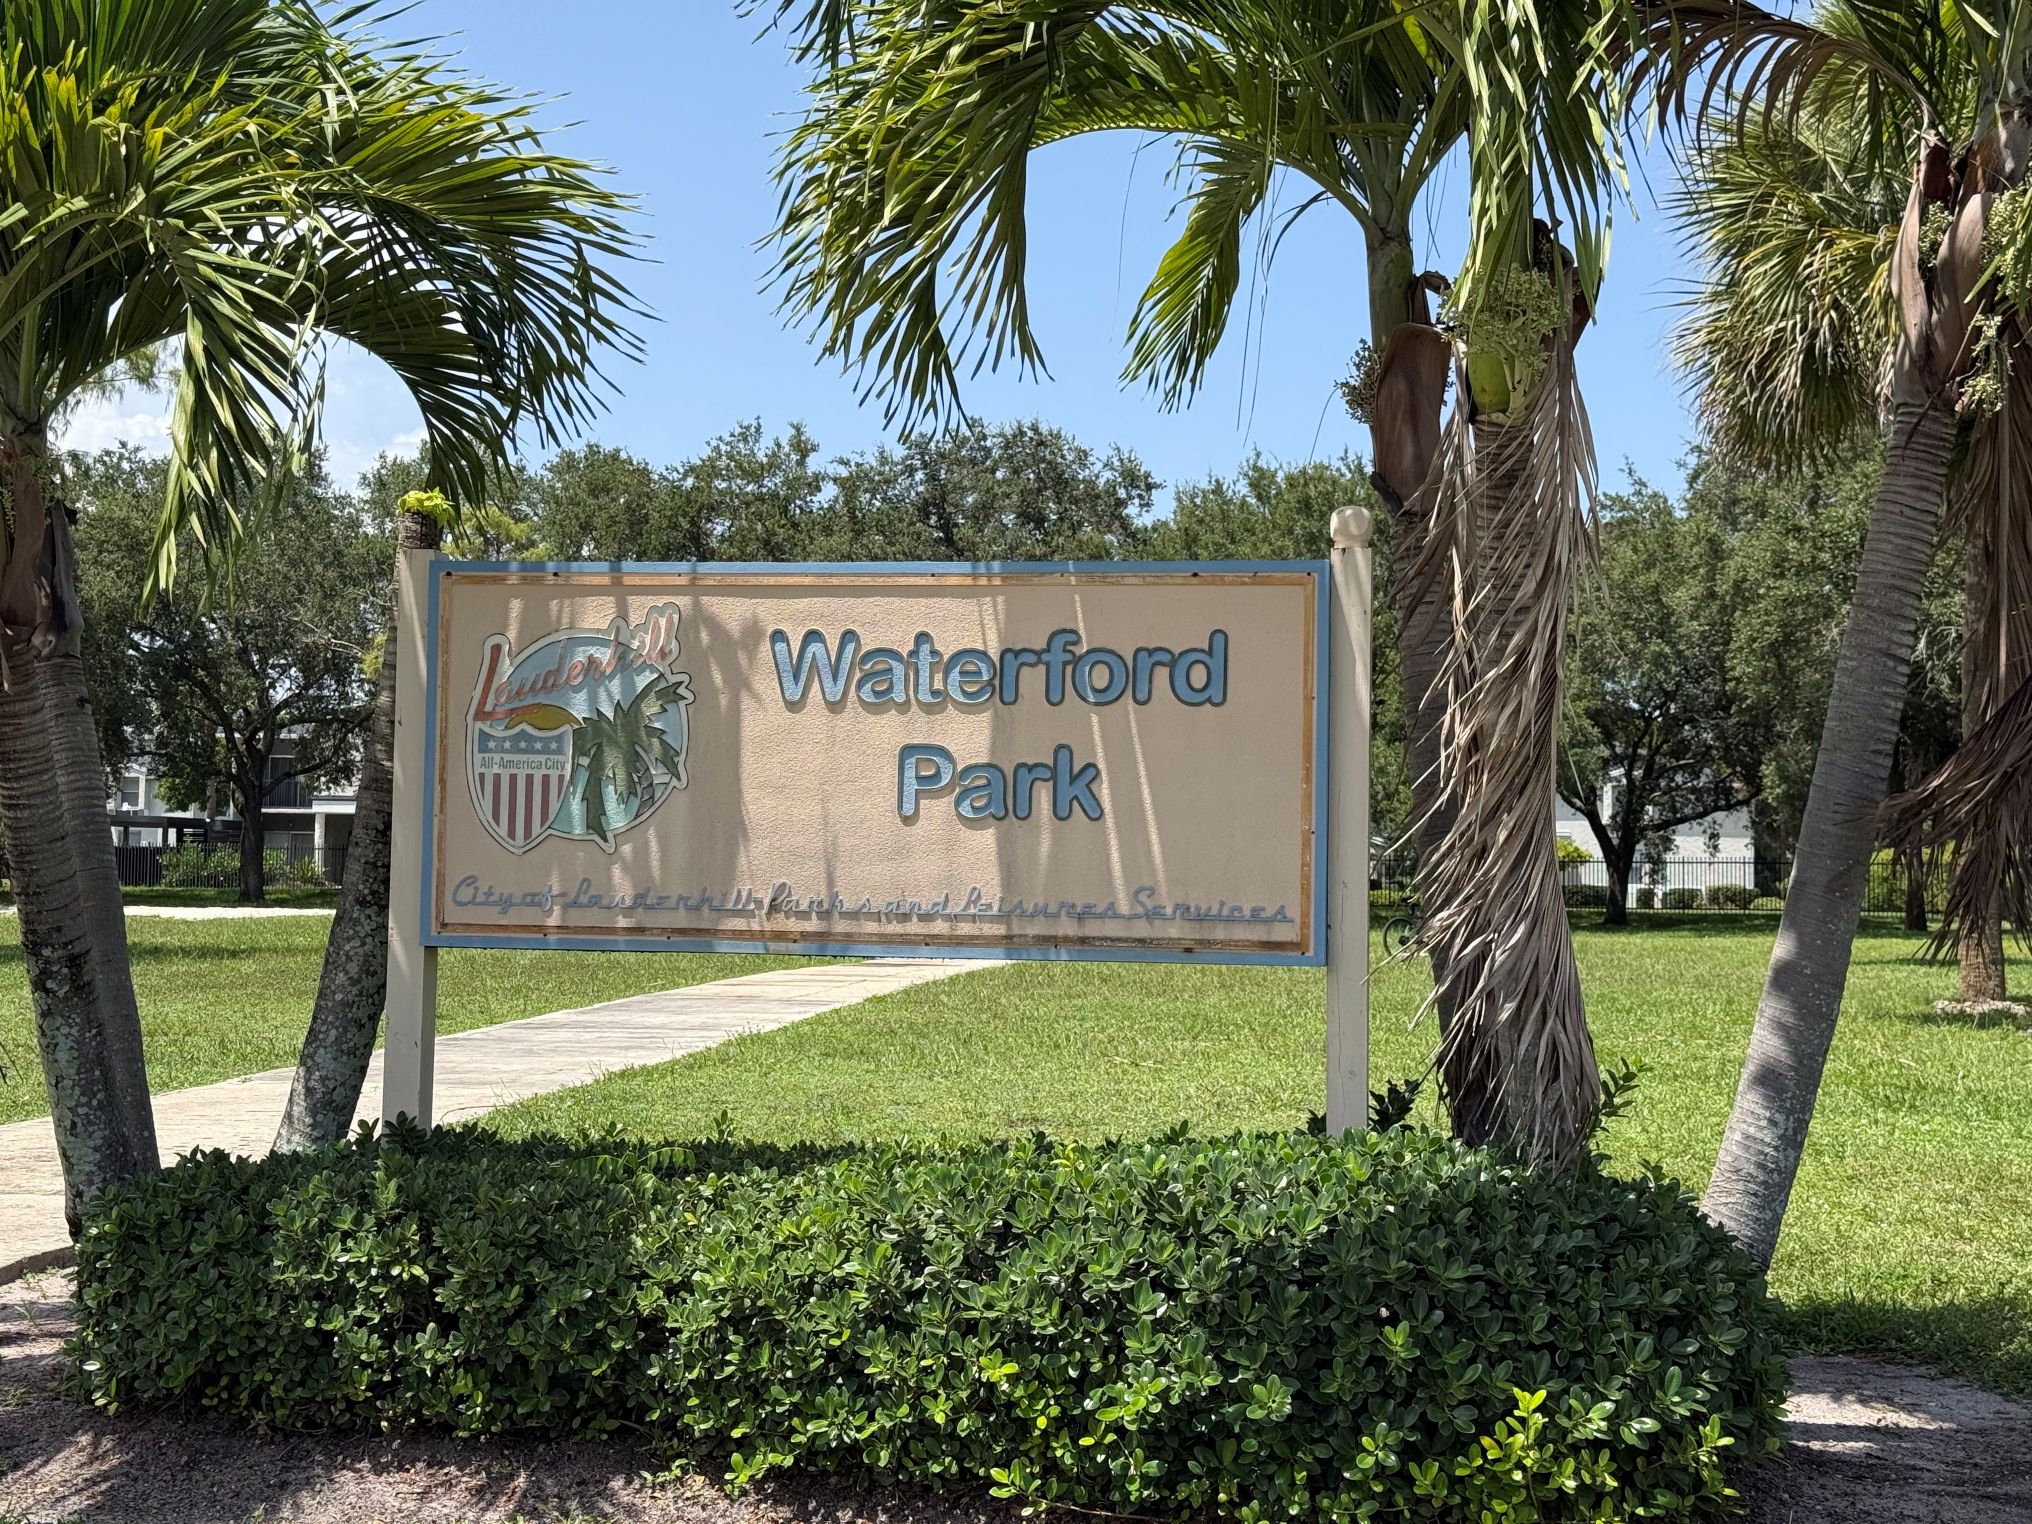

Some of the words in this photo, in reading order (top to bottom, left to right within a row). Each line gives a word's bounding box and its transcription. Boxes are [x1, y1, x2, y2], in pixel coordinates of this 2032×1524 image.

[472, 611, 673, 722] Lauderhill
[769, 628, 1227, 706] Waterford
[479, 756, 542, 770] All-America
[544, 757, 566, 772] City
[897, 743, 1103, 821] Park
[452, 874, 514, 914] City
[517, 884, 566, 913] of
[565, 876, 755, 911] Lauderhill
[763, 881, 881, 916] Parks
[881, 891, 953, 916] and
[1126, 885, 1294, 922] Services
